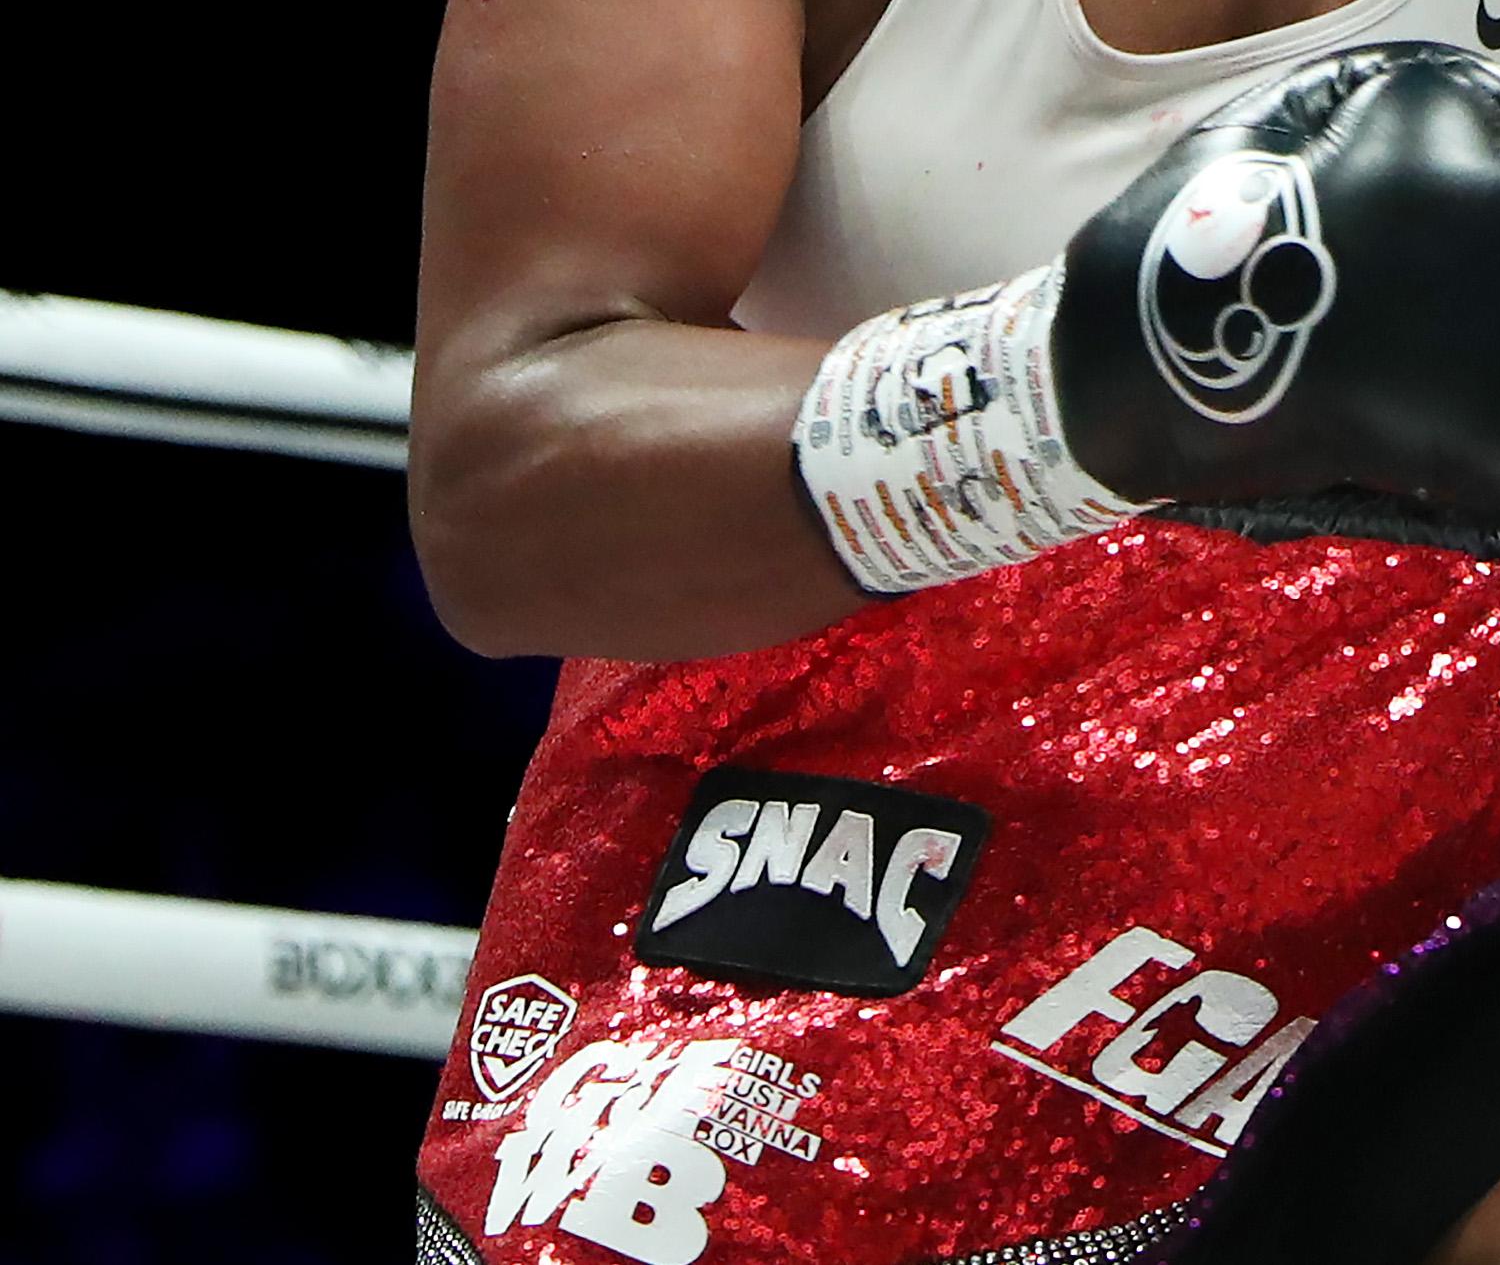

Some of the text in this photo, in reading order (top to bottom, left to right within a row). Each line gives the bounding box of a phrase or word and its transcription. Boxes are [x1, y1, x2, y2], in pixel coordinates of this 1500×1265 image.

[652, 799, 961, 968] SNAC
[484, 993, 565, 1031] SAFE
[1000, 925, 1318, 1146] FGA
[724, 1075, 796, 1115] UST
[730, 1046, 822, 1098] GIRLS
[694, 1118, 757, 1162] BOX
